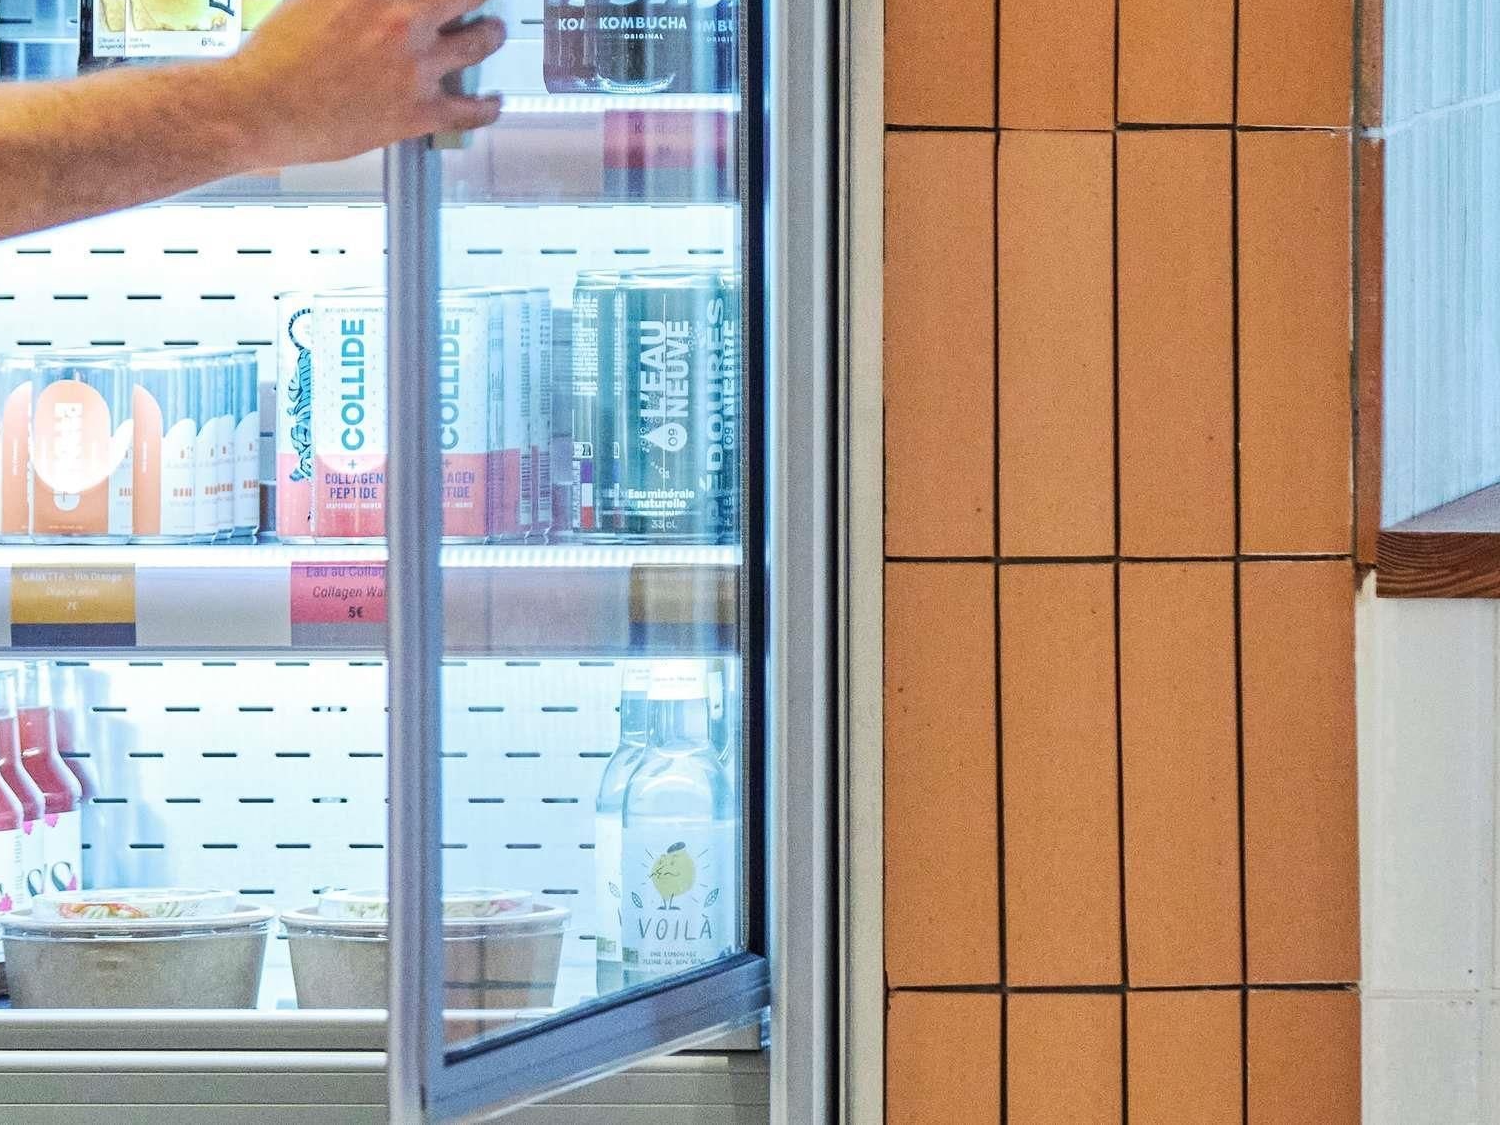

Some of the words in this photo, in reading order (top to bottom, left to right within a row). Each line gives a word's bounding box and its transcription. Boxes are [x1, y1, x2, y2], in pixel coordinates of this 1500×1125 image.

[599, 16, 687, 31] KOMBUCHA
[666, 321, 689, 417] NEUVE
[341, 320, 364, 450] COLLIDE
[325, 473, 384, 484] COLLAGEN
[330, 487, 377, 499] PEPTIDE
[637, 499, 687, 509] naturelle
[312, 586, 362, 600] Collagen
[348, 607, 363, 618] 5€
[638, 914, 712, 940] VOILÀ
